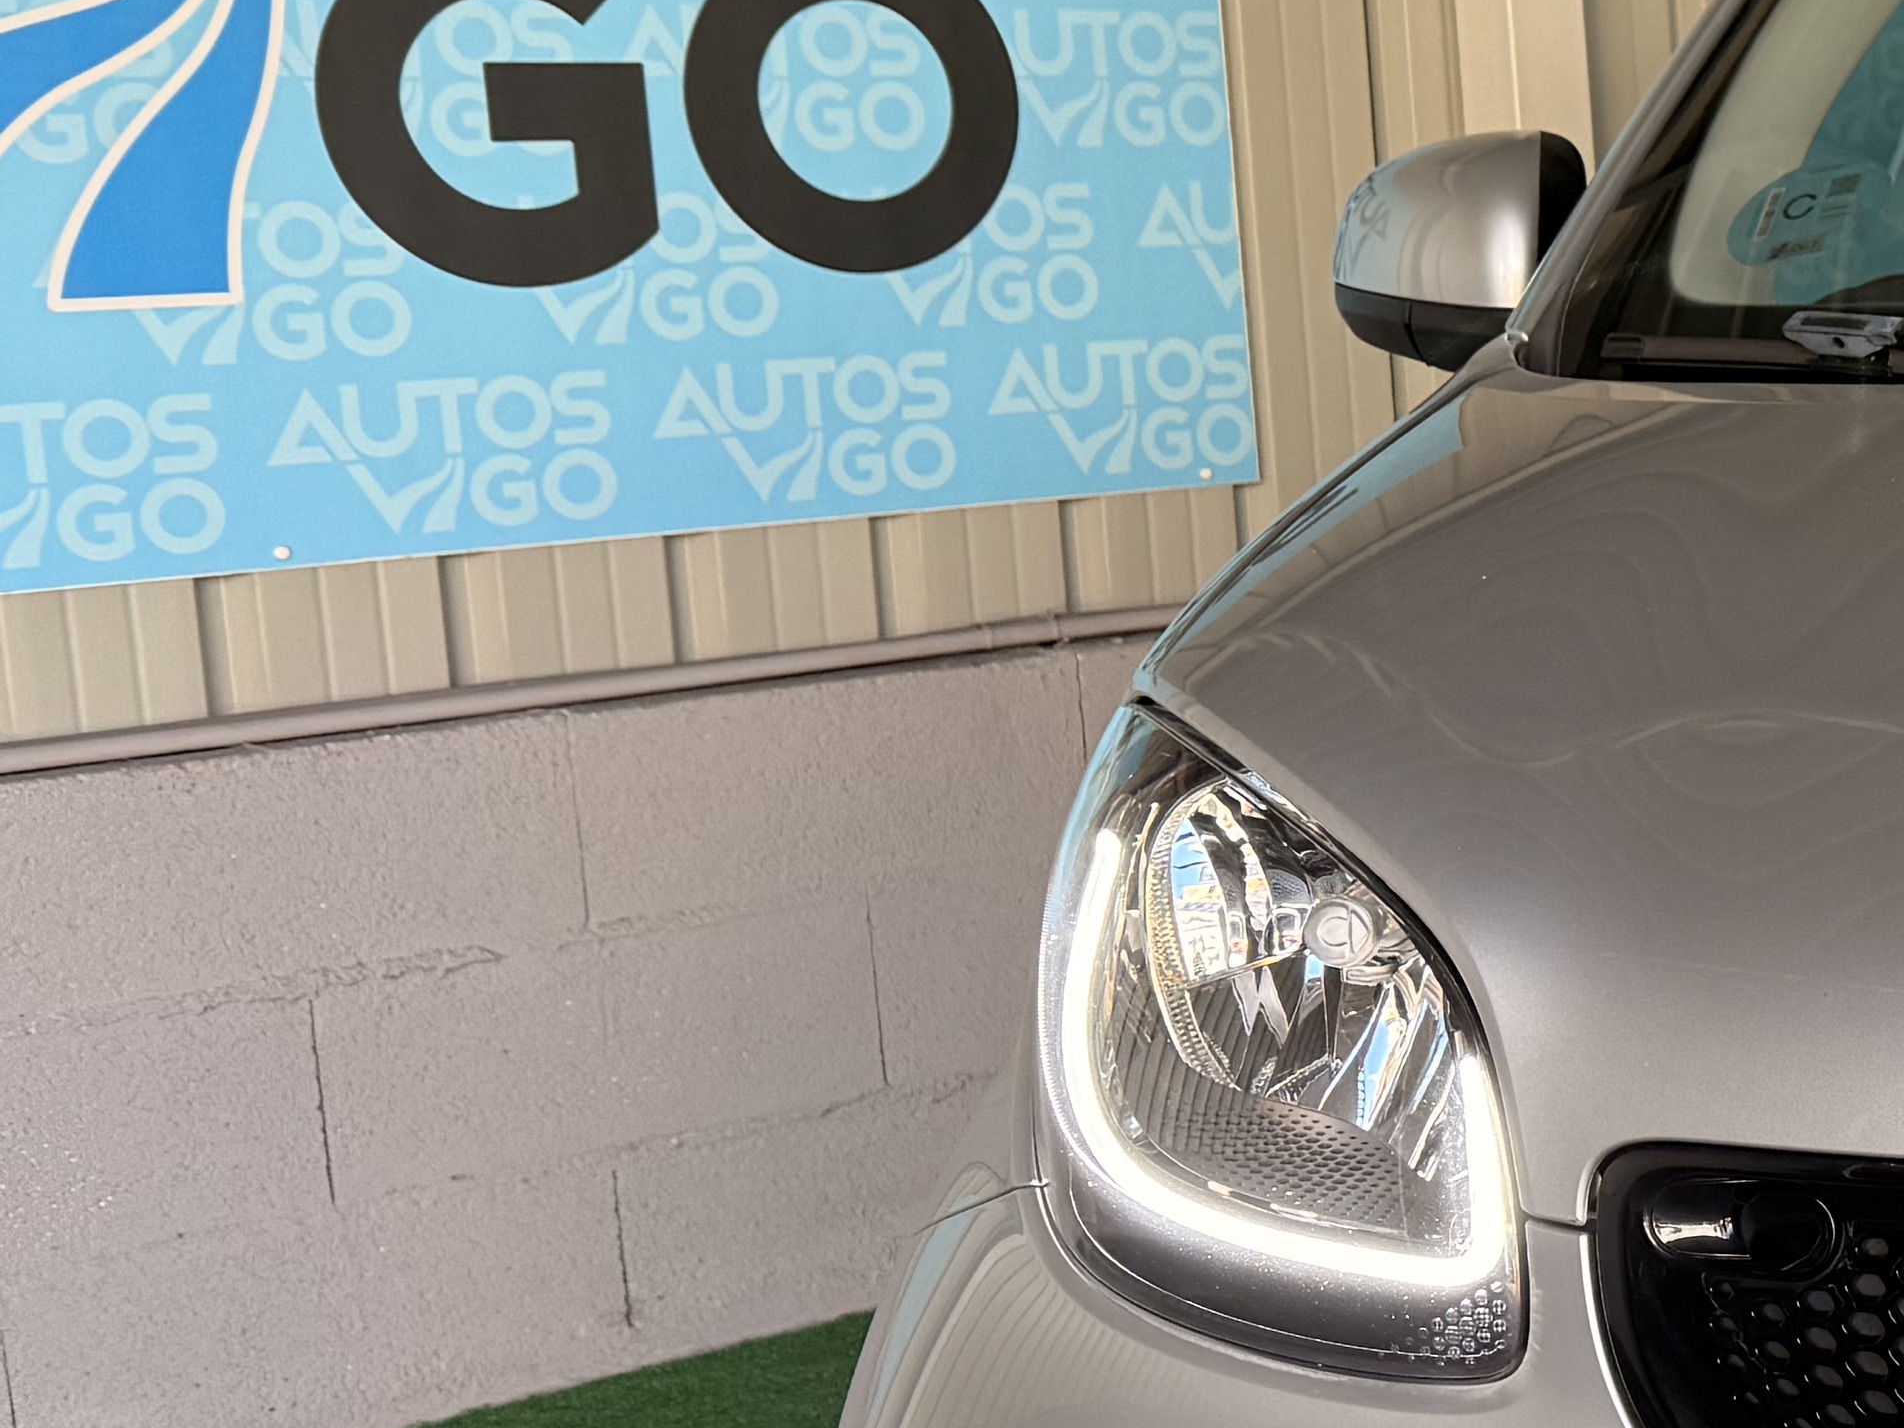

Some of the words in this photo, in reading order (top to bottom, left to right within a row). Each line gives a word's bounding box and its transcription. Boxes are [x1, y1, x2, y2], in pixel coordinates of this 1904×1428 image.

[1013, 8, 1222, 77] UTOS
[1782, 192, 1818, 221] C
[652, 350, 951, 440] AUTOS
[987, 335, 1247, 416] AUTOS
[267, 370, 612, 467] AUTOS
[1048, 404, 1254, 476] VIGO
[345, 448, 619, 534] VIGO
[720, 423, 957, 503] VIGO
